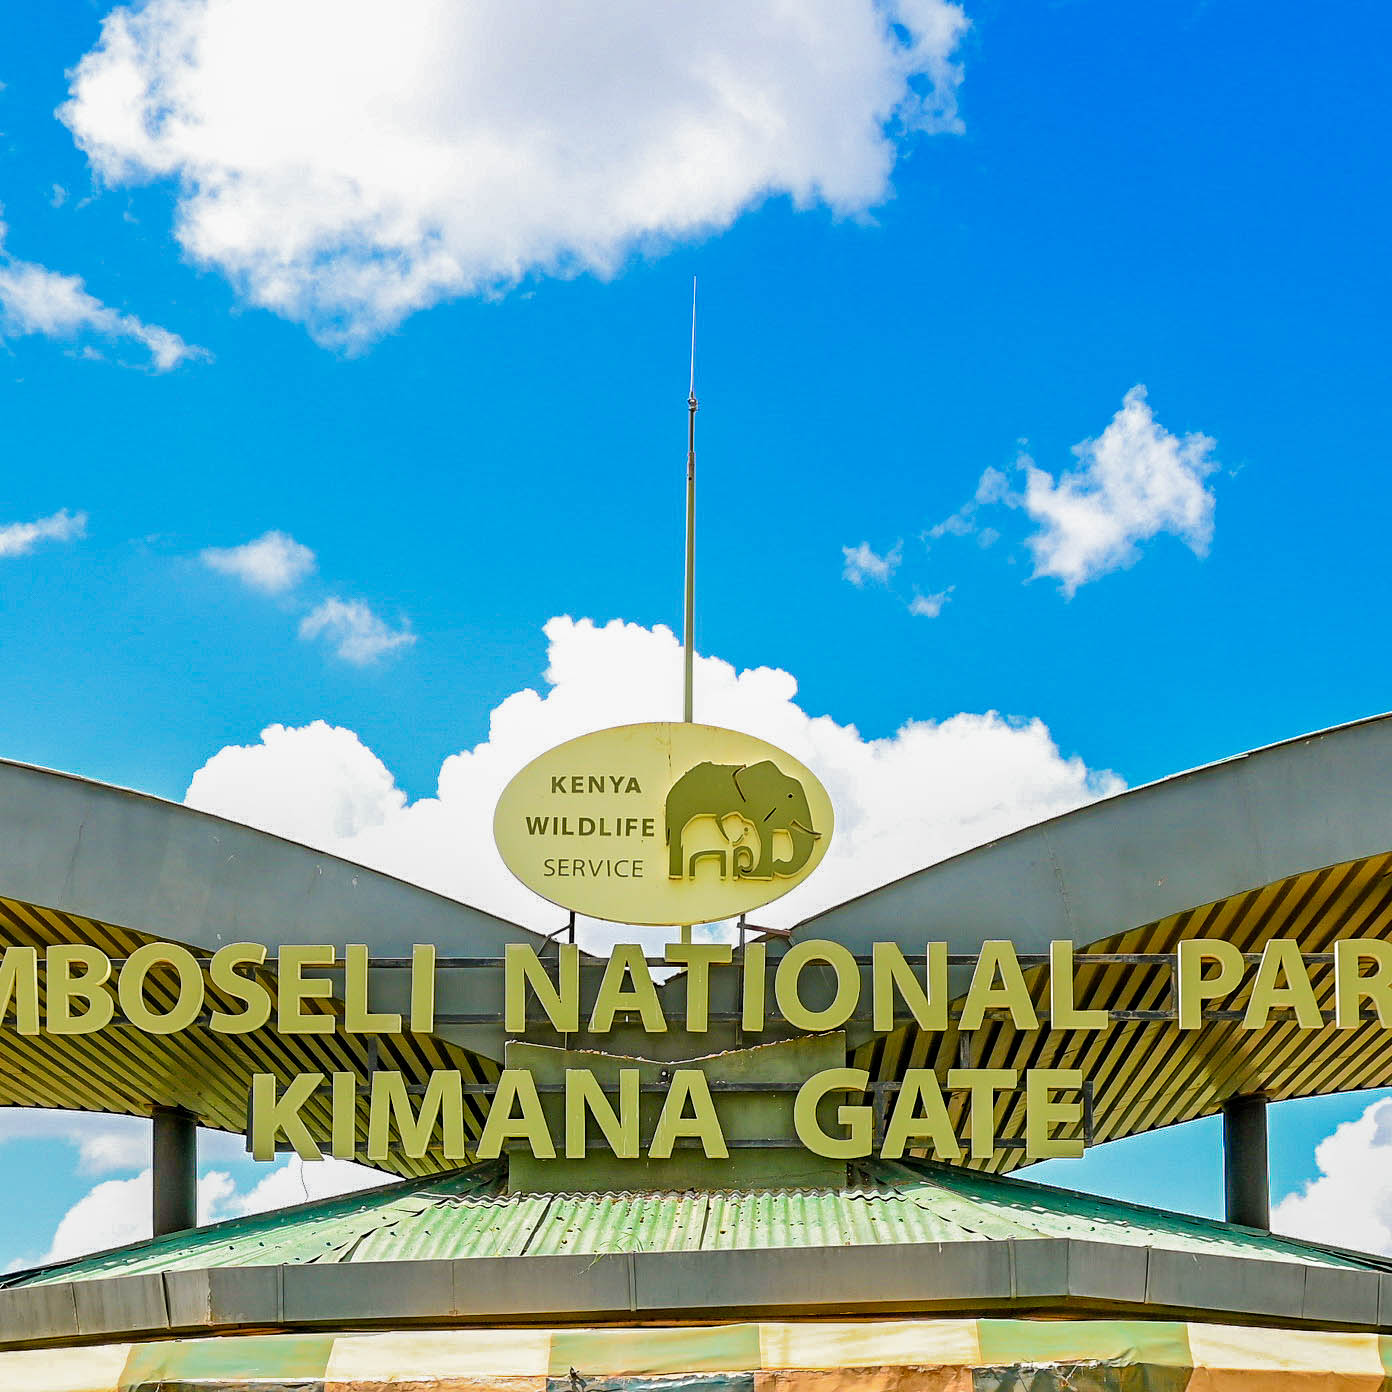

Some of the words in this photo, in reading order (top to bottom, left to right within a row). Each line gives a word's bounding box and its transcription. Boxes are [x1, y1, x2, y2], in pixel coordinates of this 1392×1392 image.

[551, 775, 642, 794] KENYA
[525, 816, 655, 837] WILDLIFE
[543, 858, 644, 878] SERVICE
[504, 940, 1110, 1033] NATIONAL
[253, 1069, 729, 1161] KIMANA
[794, 1068, 1084, 1160] GATE
